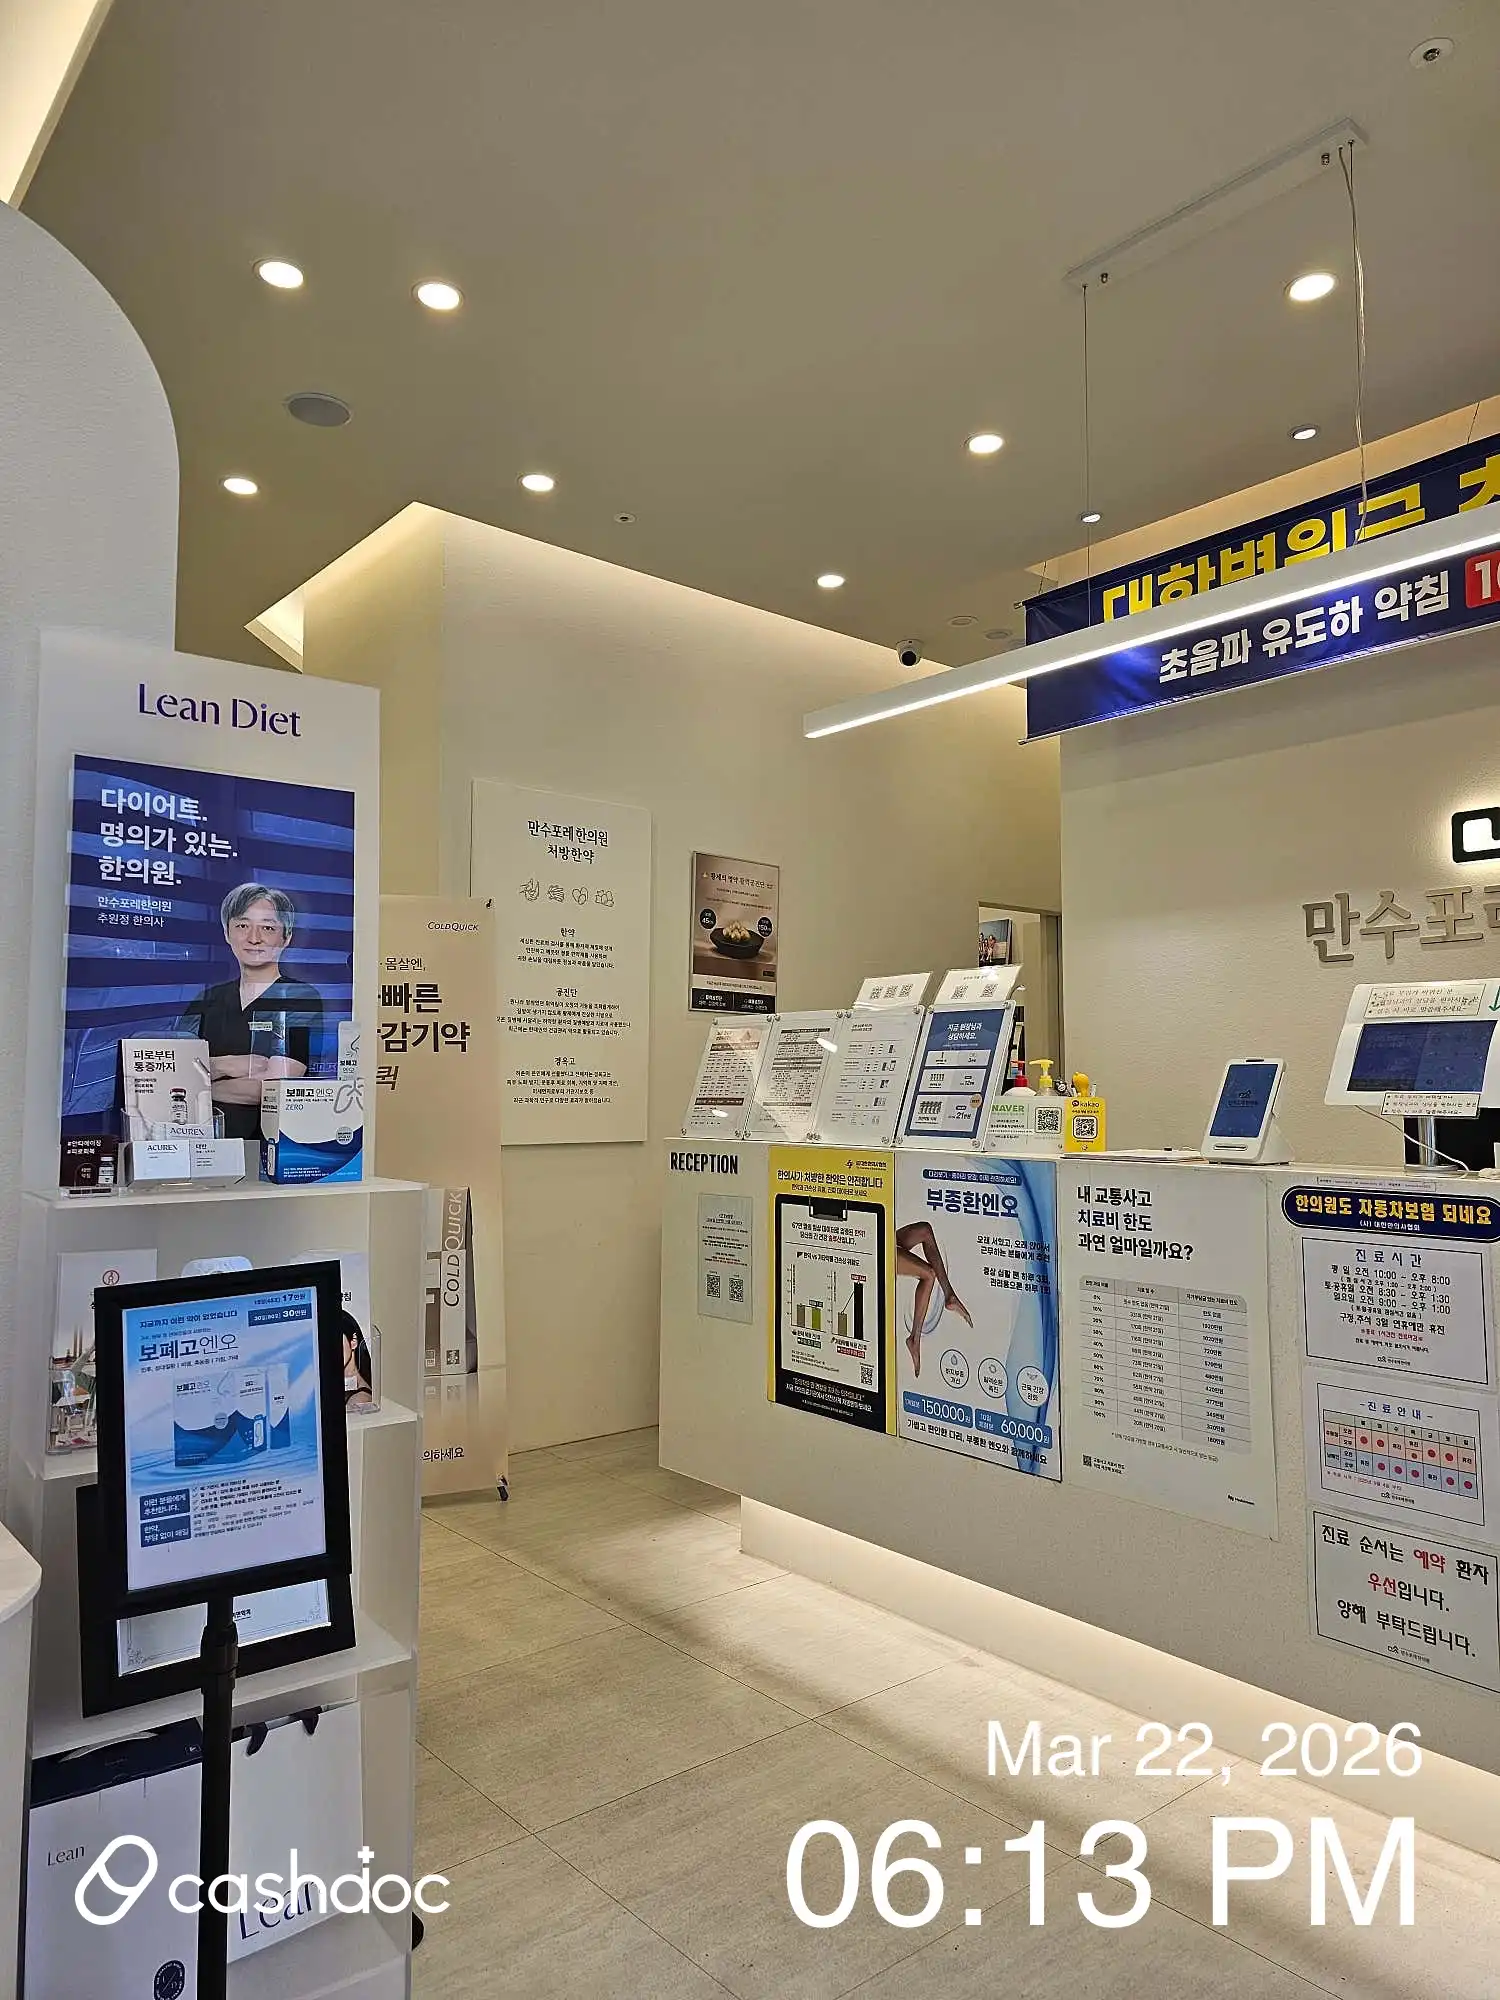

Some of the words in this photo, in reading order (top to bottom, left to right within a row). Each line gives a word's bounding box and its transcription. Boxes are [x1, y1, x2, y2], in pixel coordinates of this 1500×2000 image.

[1159, 629, 1251, 683] 초음파
[1263, 596, 1363, 657] 유도하
[1374, 570, 1449, 621] 약침
[138, 683, 220, 725] Lean
[232, 698, 301, 736] Diet
[101, 789, 208, 821] 다이어트.
[100, 822, 177, 852] 명의가
[184, 831, 238, 858] 있는.
[99, 855, 182, 886] 한의원.
[98, 896, 172, 912] 만수포레한의원
[133, 915, 164, 927] 한의사
[378, 982, 442, 1013] 빠른
[556, 988, 577, 997] 공진단
[376, 1021, 471, 1053] 감기약
[133, 1050, 175, 1060] 피로부터
[134, 1061, 176, 1072] 통증까지
[555, 1057, 575, 1066] 경옥고
[671, 1152, 738, 1175] RECEPTION
[804, 1172, 824, 1183] 처방한
[927, 1189, 1018, 1217] 부종환엔오
[1077, 1185, 1092, 1204] 내
[1094, 1187, 1153, 1208] 교통사고
[1077, 1209, 1120, 1231] 치료비
[1123, 1212, 1153, 1233] 한도
[1296, 1194, 1353, 1216] 한의원도
[1359, 1198, 1435, 1222] 자동차보험
[1442, 1203, 1492, 1225] 되네요
[977, 1236, 990, 1244] 오래
[981, 1246, 1006, 1257] 근무하는
[1078, 1232, 1106, 1253] 과연
[1109, 1235, 1194, 1261] 얼마일까요?
[1355, 1267, 1369, 1277] 오전
[1374, 1270, 1396, 1279] 10:00
[1411, 1273, 1426, 1283] 오후
[1431, 1275, 1450, 1285] 8:00
[1360, 1285, 1373, 1295] 오전
[1379, 1288, 1396, 1297] 8:30
[1411, 1291, 1426, 1301] 오후
[1431, 1294, 1450, 1304] 1:30
[1360, 1295, 1374, 1305] 오전
[1379, 1298, 1396, 1307] 9:00
[1411, 1302, 1426, 1311] 오후
[1432, 1305, 1450, 1314] 1:00
[1376, 1318, 1388, 1327] 3일
[1429, 1324, 1445, 1335] 휴진
[139, 1334, 239, 1362] 보폐고엔오
[949, 1431, 965, 1443] 다리,
[421, 1447, 464, 1461] 의하세요
[1322, 1524, 1350, 1546] 진료
[1359, 1535, 1404, 1563] 순서는
[1413, 1549, 1446, 1573] 예약
[1455, 1559, 1489, 1585] 환자
[1368, 1572, 1450, 1612] 우선입니다.
[1337, 1600, 1366, 1624] 양해
[1376, 1610, 1476, 1657] 부탁드립니다.
[47, 1844, 86, 1866] Lean
